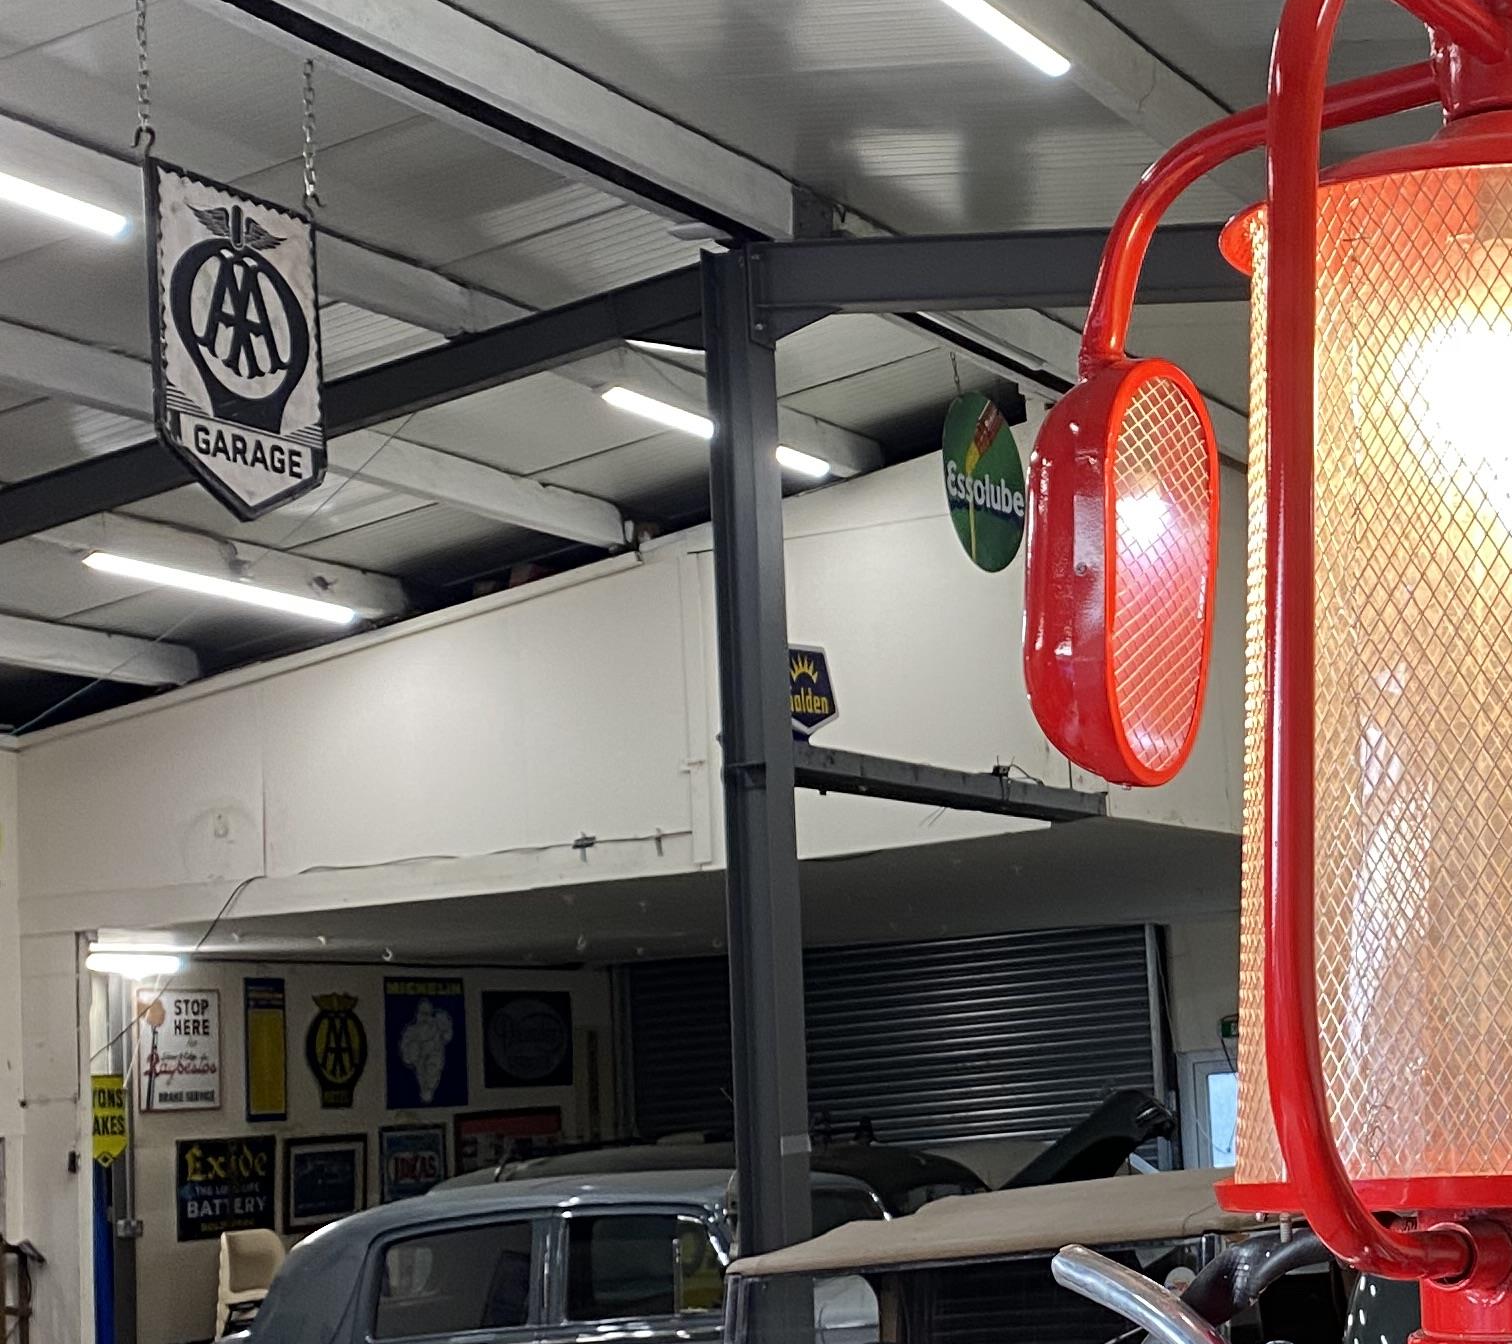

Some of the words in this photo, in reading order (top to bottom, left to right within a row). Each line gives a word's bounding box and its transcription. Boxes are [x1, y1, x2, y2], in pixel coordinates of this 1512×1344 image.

[191, 422, 304, 481] GARAGE
[946, 459, 1024, 517] Essolube
[173, 998, 210, 1017] STOP
[173, 1018, 211, 1037] HERE
[184, 1142, 269, 1183] Exide
[186, 1195, 268, 1220] BATTERY
